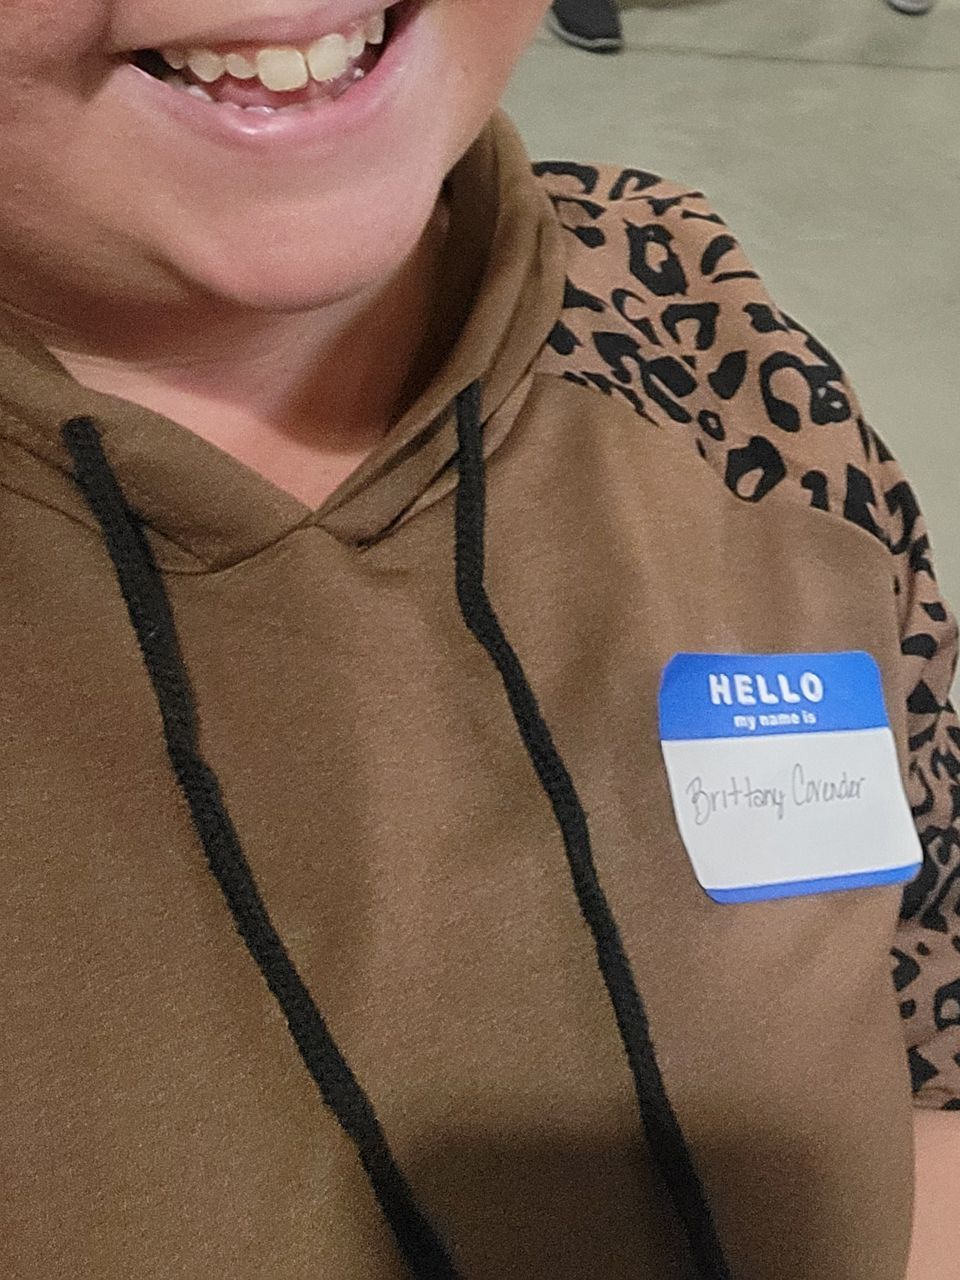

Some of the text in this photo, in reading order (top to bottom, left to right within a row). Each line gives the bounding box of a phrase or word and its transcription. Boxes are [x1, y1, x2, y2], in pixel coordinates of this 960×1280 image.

[708, 671, 824, 706] HELLO
[733, 709, 817, 731] my name is
[685, 776, 785, 826] Brittany
